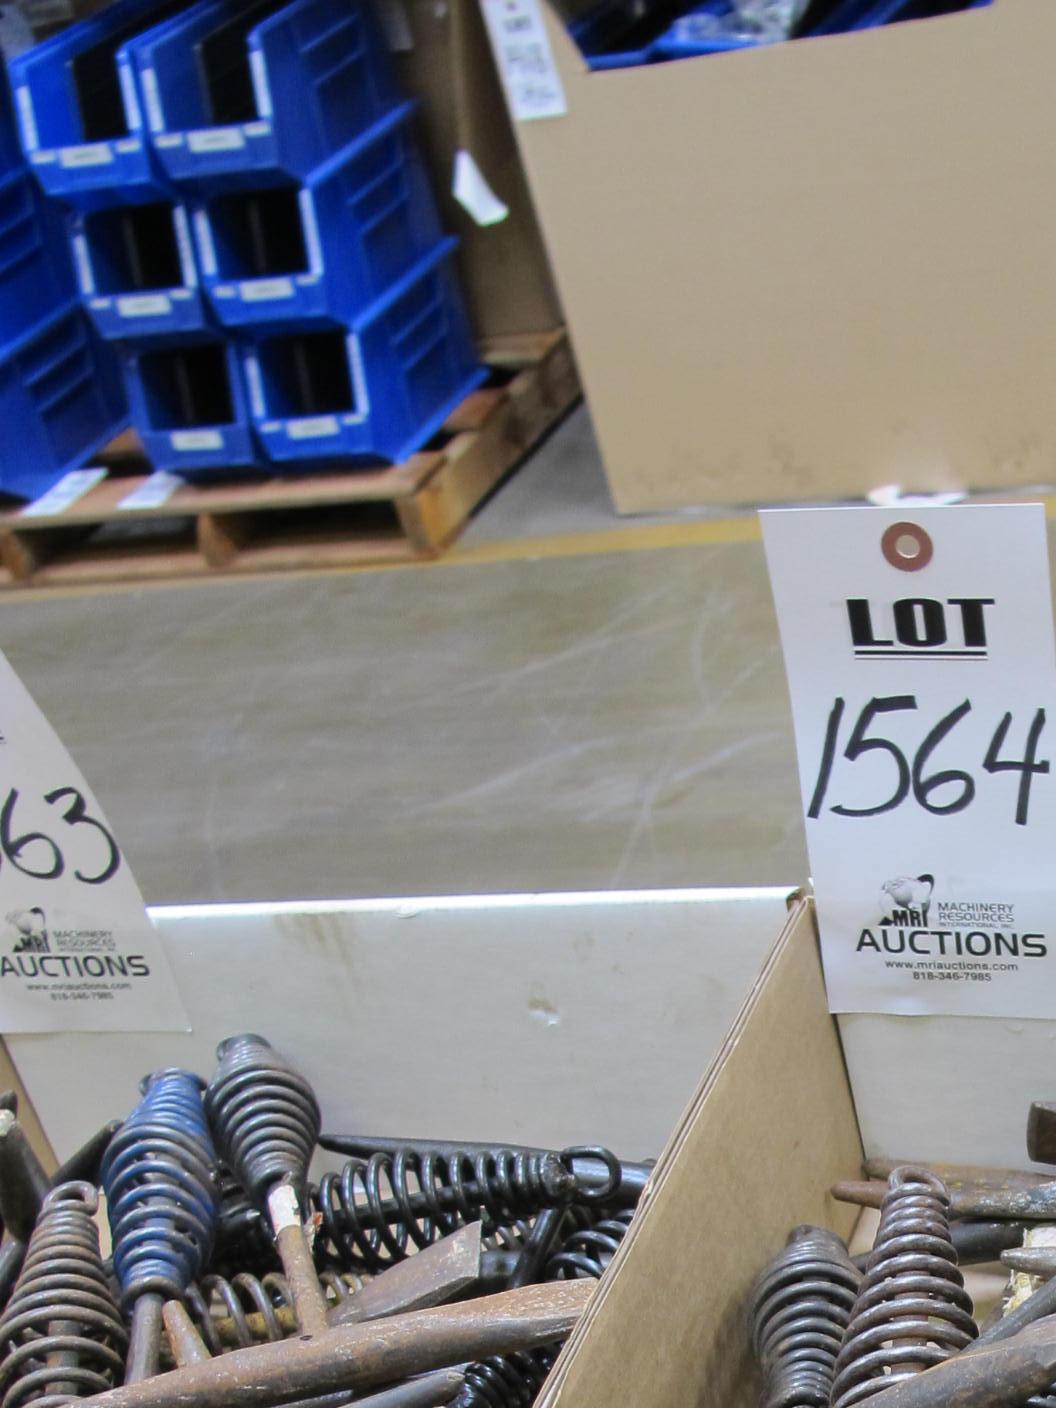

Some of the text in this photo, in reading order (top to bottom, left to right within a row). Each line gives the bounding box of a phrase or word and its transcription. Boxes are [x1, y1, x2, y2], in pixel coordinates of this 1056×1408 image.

[846, 598, 995, 648] LOT
[807, 695, 1050, 825] 1564
[0, 786, 121, 885] 63
[891, 903, 928, 927] MRI
[937, 902, 1015, 913] MACHINERY
[938, 911, 1015, 923] RESOURCES
[19, 930, 50, 953] MRI
[856, 929, 1048, 958] AUCTIONS
[0, 955, 150, 977] AUCTIONS
[885, 960, 1019, 971] www.mriauctions.com
[913, 971, 992, 982] 818-346-7985
